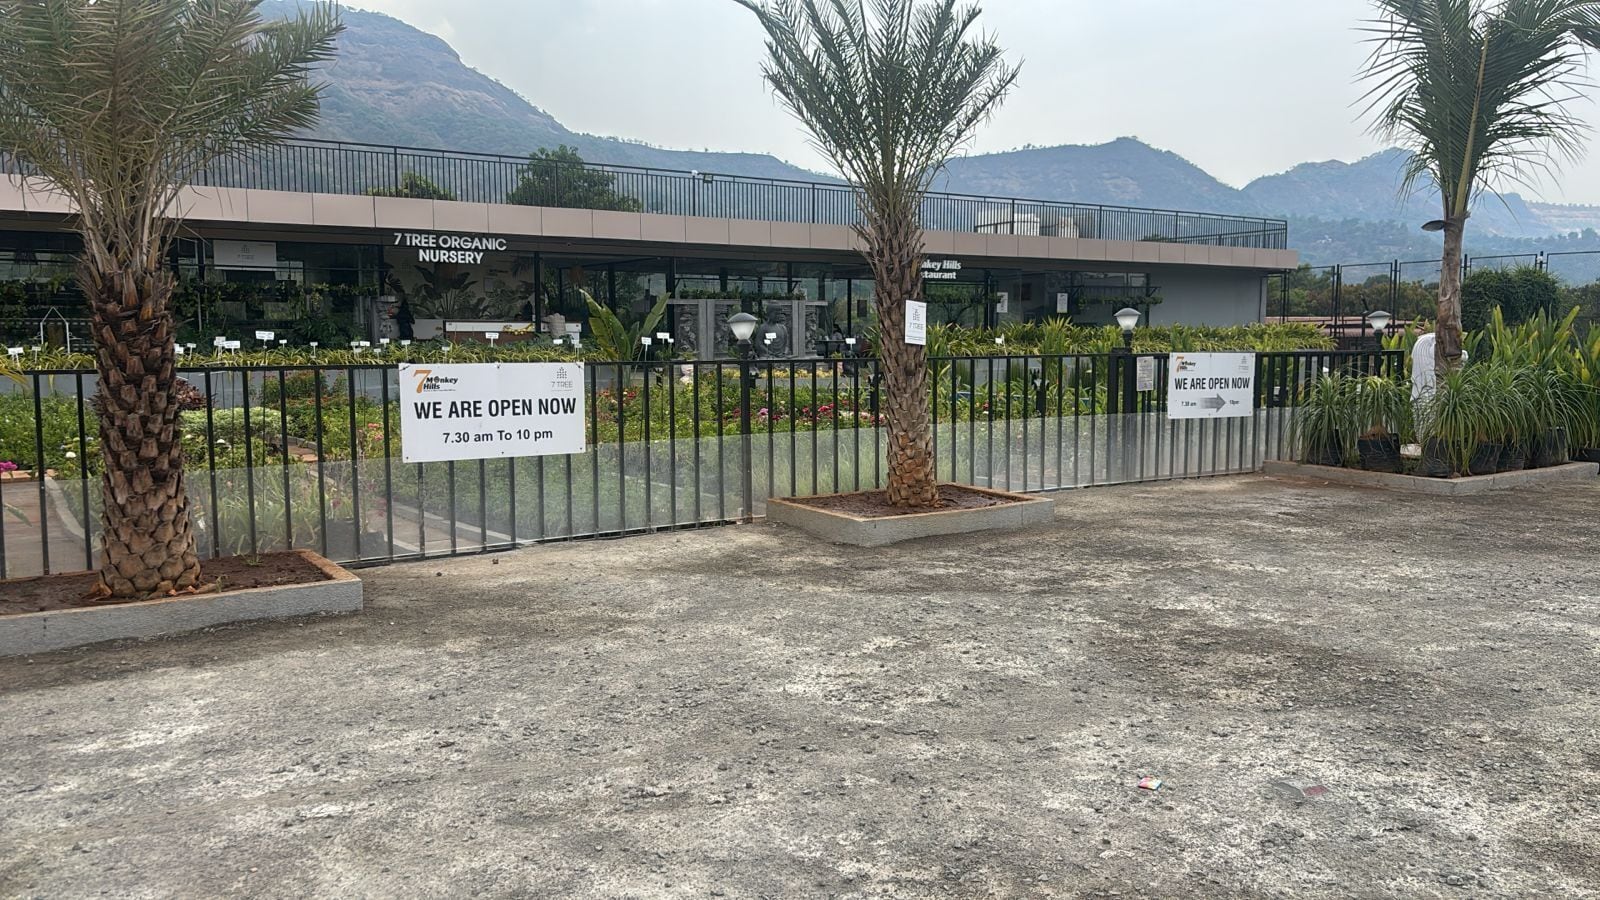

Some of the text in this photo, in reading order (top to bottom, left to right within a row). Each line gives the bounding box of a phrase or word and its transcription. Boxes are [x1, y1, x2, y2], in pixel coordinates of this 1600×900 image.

[393, 232, 507, 251] 7 TREE ORGANIC
[419, 248, 484, 264] NURSERY
[942, 259, 961, 270] Hills
[412, 369, 433, 394] 7
[556, 381, 574, 389] TREE
[1174, 376, 1251, 390] WE ARE OPEN NOW
[414, 397, 577, 420] WE ARE OPEN NOW
[442, 428, 553, 444] 7.30 am To 10 pm
